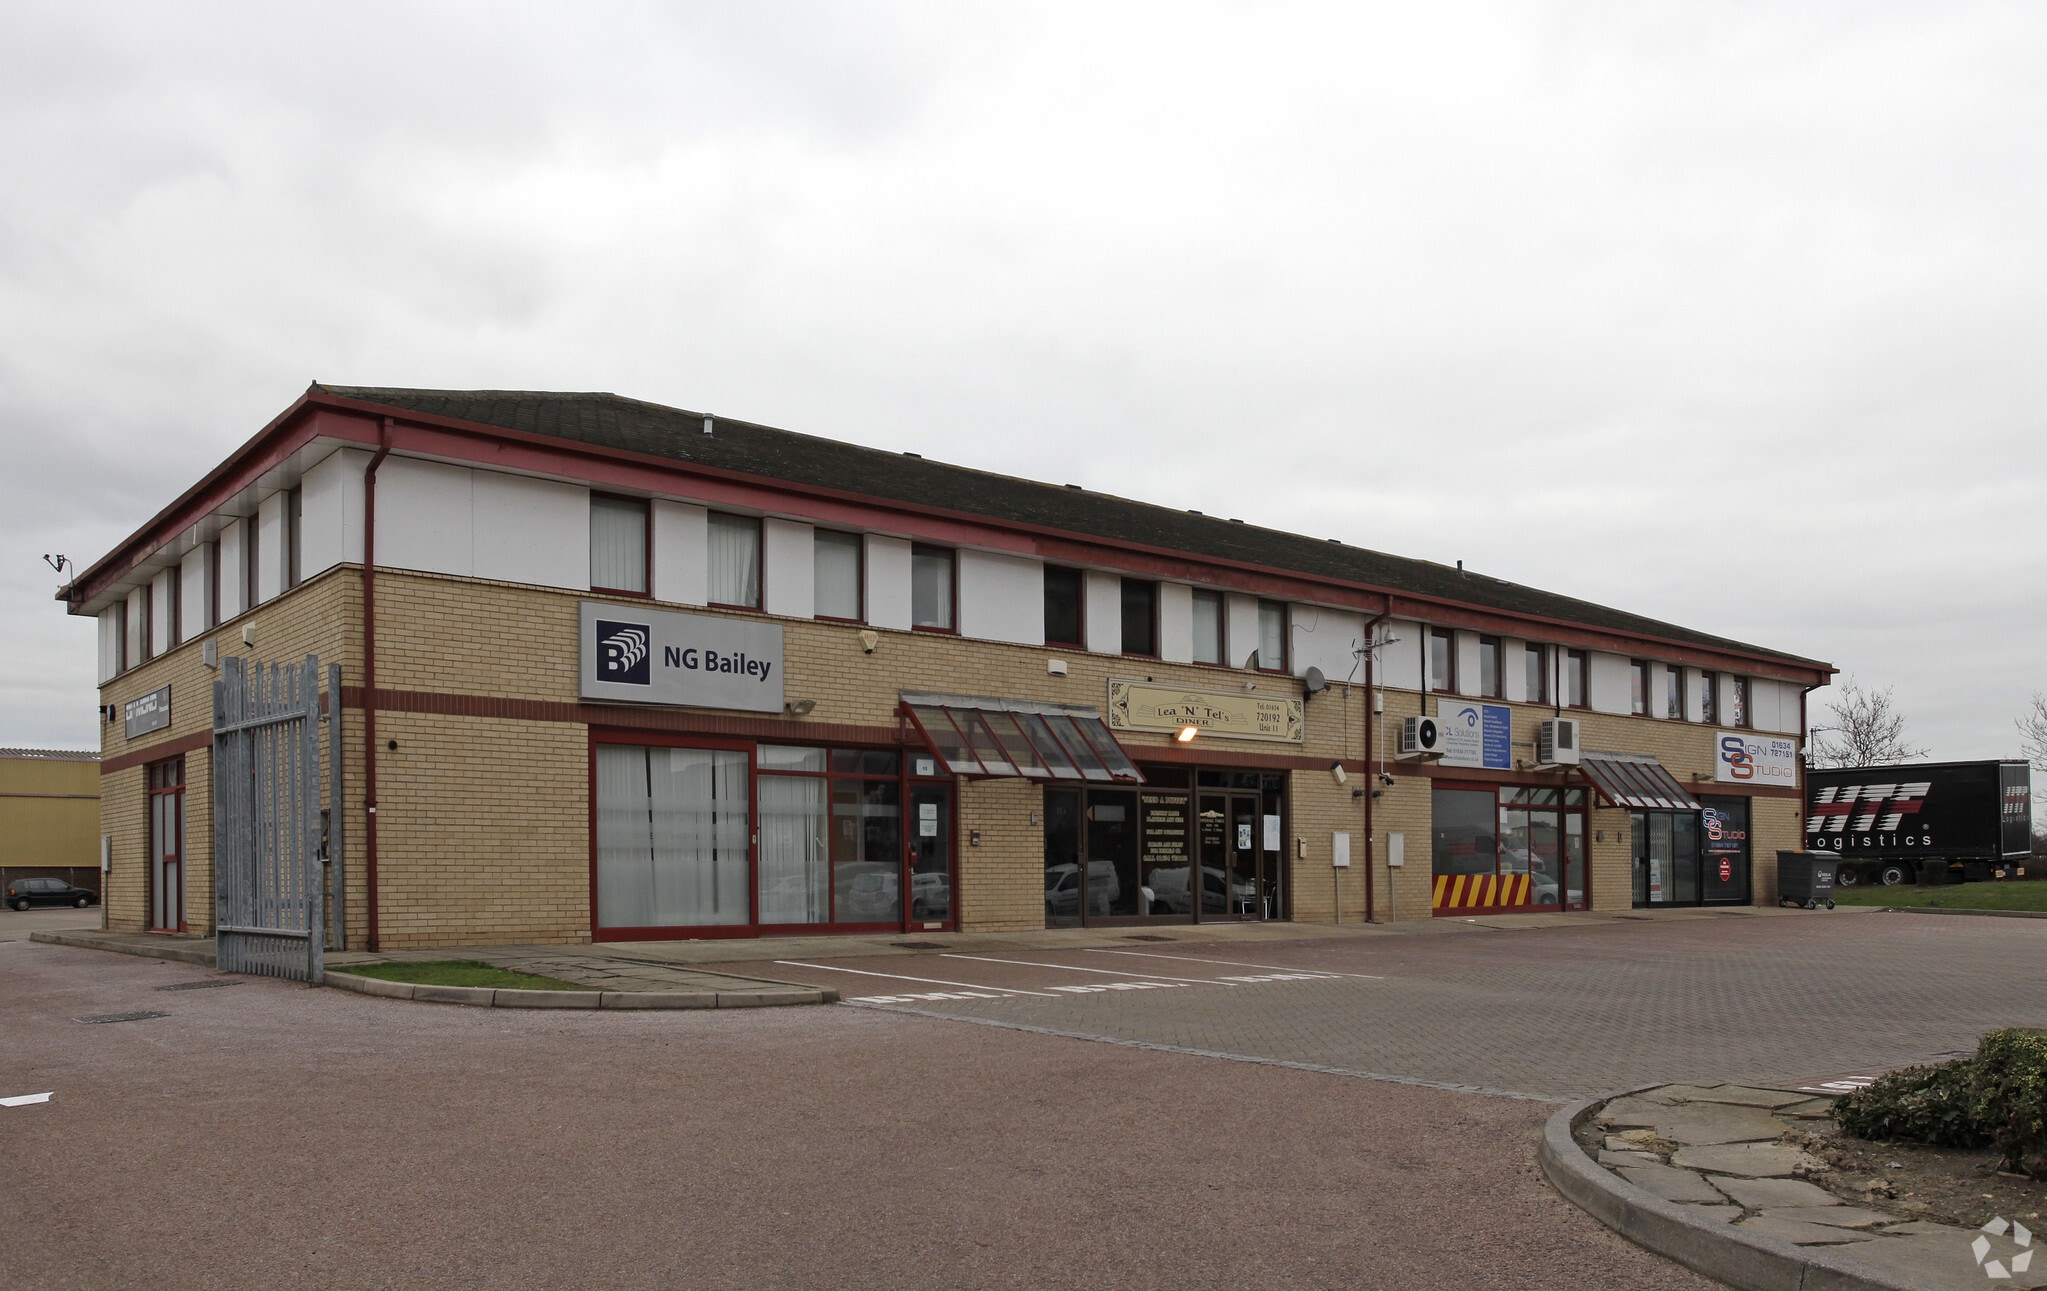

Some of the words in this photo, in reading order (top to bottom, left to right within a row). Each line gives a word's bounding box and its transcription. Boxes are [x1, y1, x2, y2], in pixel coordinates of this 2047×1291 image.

[664, 645, 698, 670] NG
[705, 651, 771, 682] Bailey
[1158, 708, 1177, 717] Lea
[1204, 707, 1230, 722] Tel's
[1256, 712, 1281, 723] 720192
[1176, 717, 1209, 726] DINER
[1259, 723, 1271, 732] Unit
[1455, 727, 1480, 738] Solutions
[1771, 740, 1791, 749] 01634
[1770, 749, 1793, 758] 727151
[1805, 834, 1932, 850] ogistics
